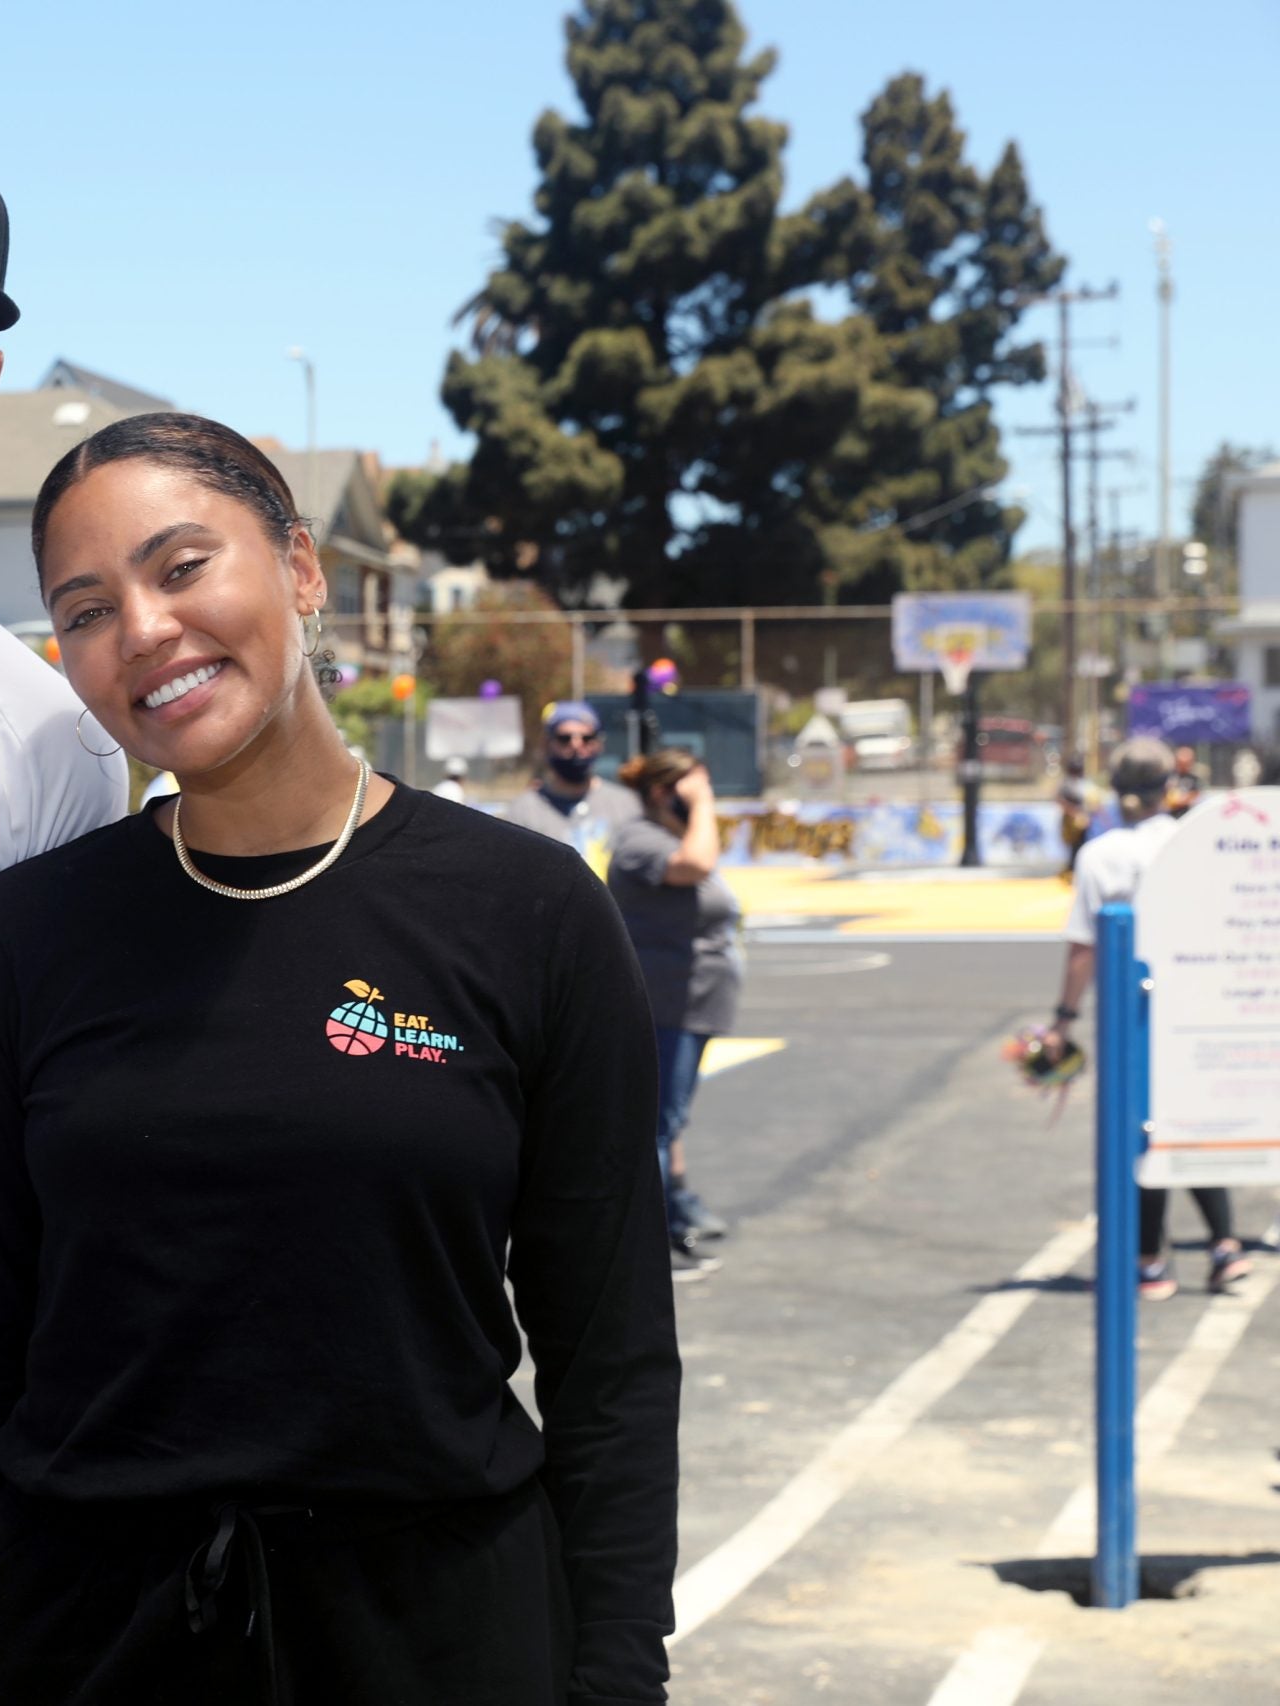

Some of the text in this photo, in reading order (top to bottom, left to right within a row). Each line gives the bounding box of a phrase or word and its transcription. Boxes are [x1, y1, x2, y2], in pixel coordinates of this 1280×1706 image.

[393, 1012, 434, 1031] EAT.
[394, 1027, 465, 1051] LEARN.
[395, 1042, 447, 1064] PLAY.
